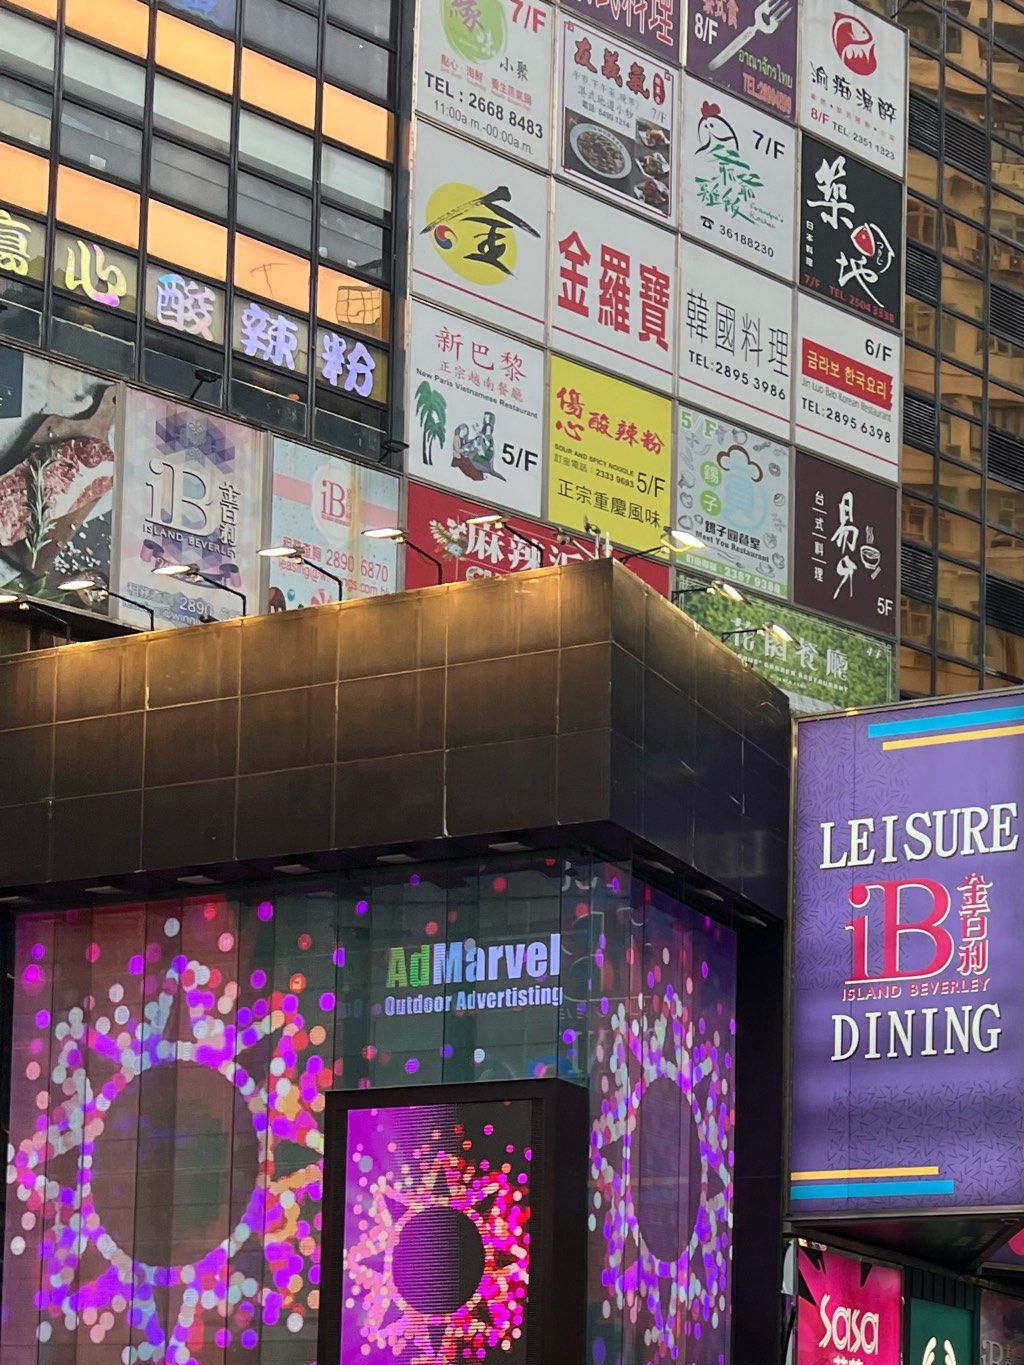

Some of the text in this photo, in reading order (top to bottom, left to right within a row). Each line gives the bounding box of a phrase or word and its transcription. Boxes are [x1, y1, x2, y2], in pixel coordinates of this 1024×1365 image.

[511, 0, 547, 33] 7/F
[694, 12, 719, 45] 8/F
[469, 92, 504, 120] 2668
[509, 111, 543, 139] 8483
[810, 107, 830, 124] 8/F
[752, 130, 785, 159] 7/F
[719, 224, 774, 258] 36188230
[557, 230, 670, 351] 金羅寶
[686, 289, 789, 377] 韓國料理
[435, 326, 527, 381] 新巴黎
[865, 339, 892, 361] 6/F
[753, 377, 786, 400] 3986
[808, 350, 887, 399] 금라보 한국요리
[416, 368, 538, 419] New Paris Vietnamese Restaurant
[681, 411, 717, 438] 5/F
[861, 422, 891, 443] 6398
[501, 443, 538, 471] 5/F
[574, 450, 588, 460] AND
[321, 480, 346, 518] iB
[637, 472, 665, 498] 5/F
[557, 478, 661, 529] 正宗重慶風味
[143, 524, 184, 543] ISLAND
[326, 549, 388, 582] 2890 6870
[877, 597, 893, 616] 5F
[820, 802, 1018, 870] LEISURE
[845, 878, 953, 982] iB
[957, 873, 991, 975] 金百利
[386, 934, 561, 988] AdMarvel
[385, 994, 452, 1016] Outdoor
[841, 978, 991, 1002] ISLAND BEVERLEY
[831, 1003, 1002, 1062] DINING
